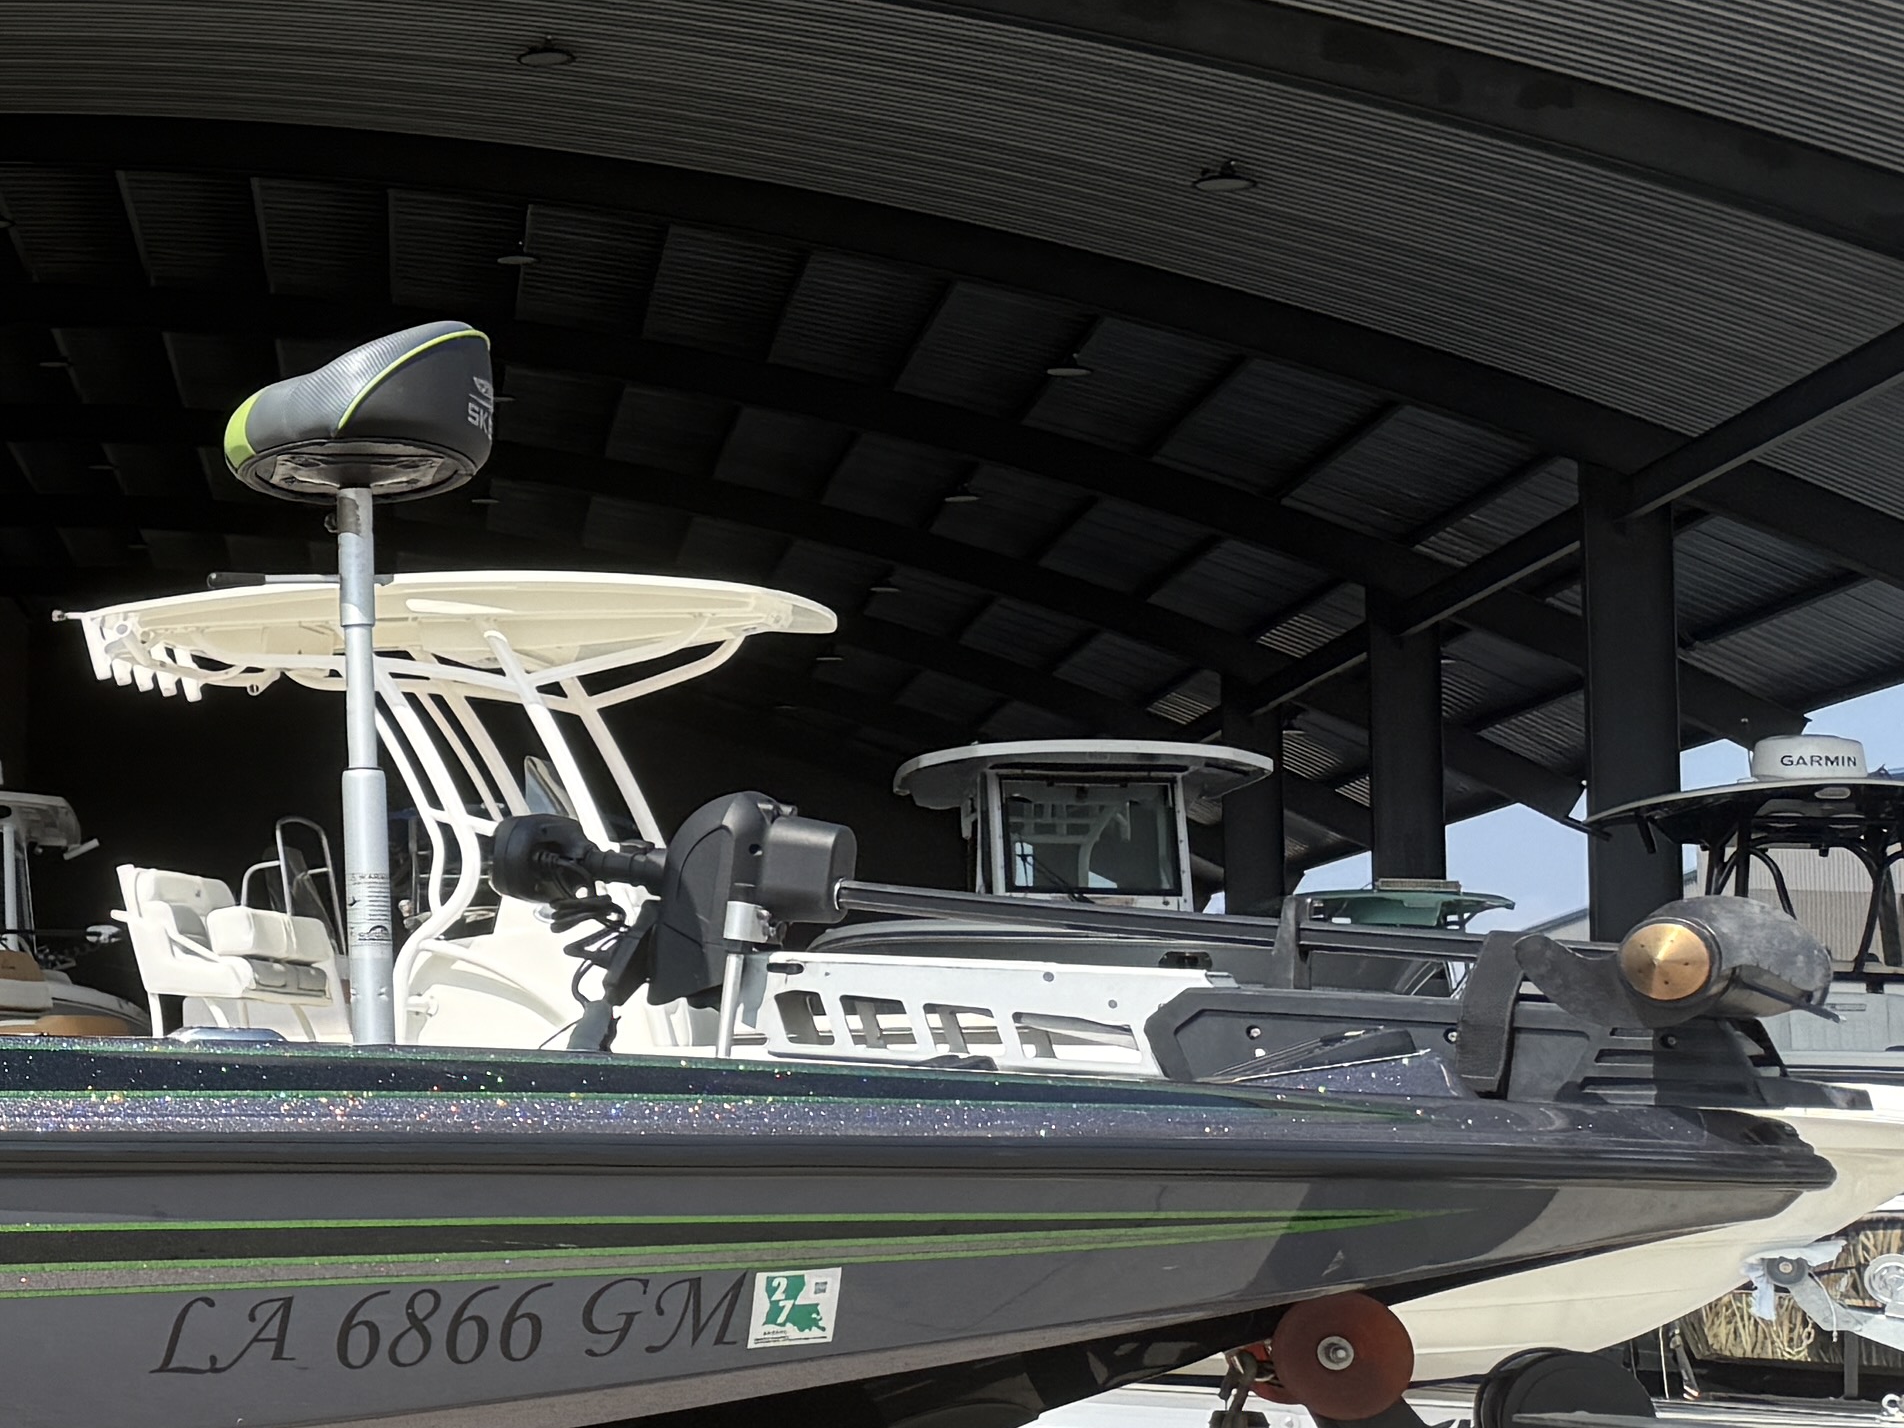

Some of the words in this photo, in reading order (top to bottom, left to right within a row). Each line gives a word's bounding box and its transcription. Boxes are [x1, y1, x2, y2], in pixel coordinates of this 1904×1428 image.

[1780, 755, 1857, 767] GARMIN
[771, 1277, 788, 1301] 2
[150, 1296, 296, 1375] LA
[335, 1282, 555, 1369] 6866
[582, 1269, 753, 1358] GM
[776, 1299, 794, 1324] 7
